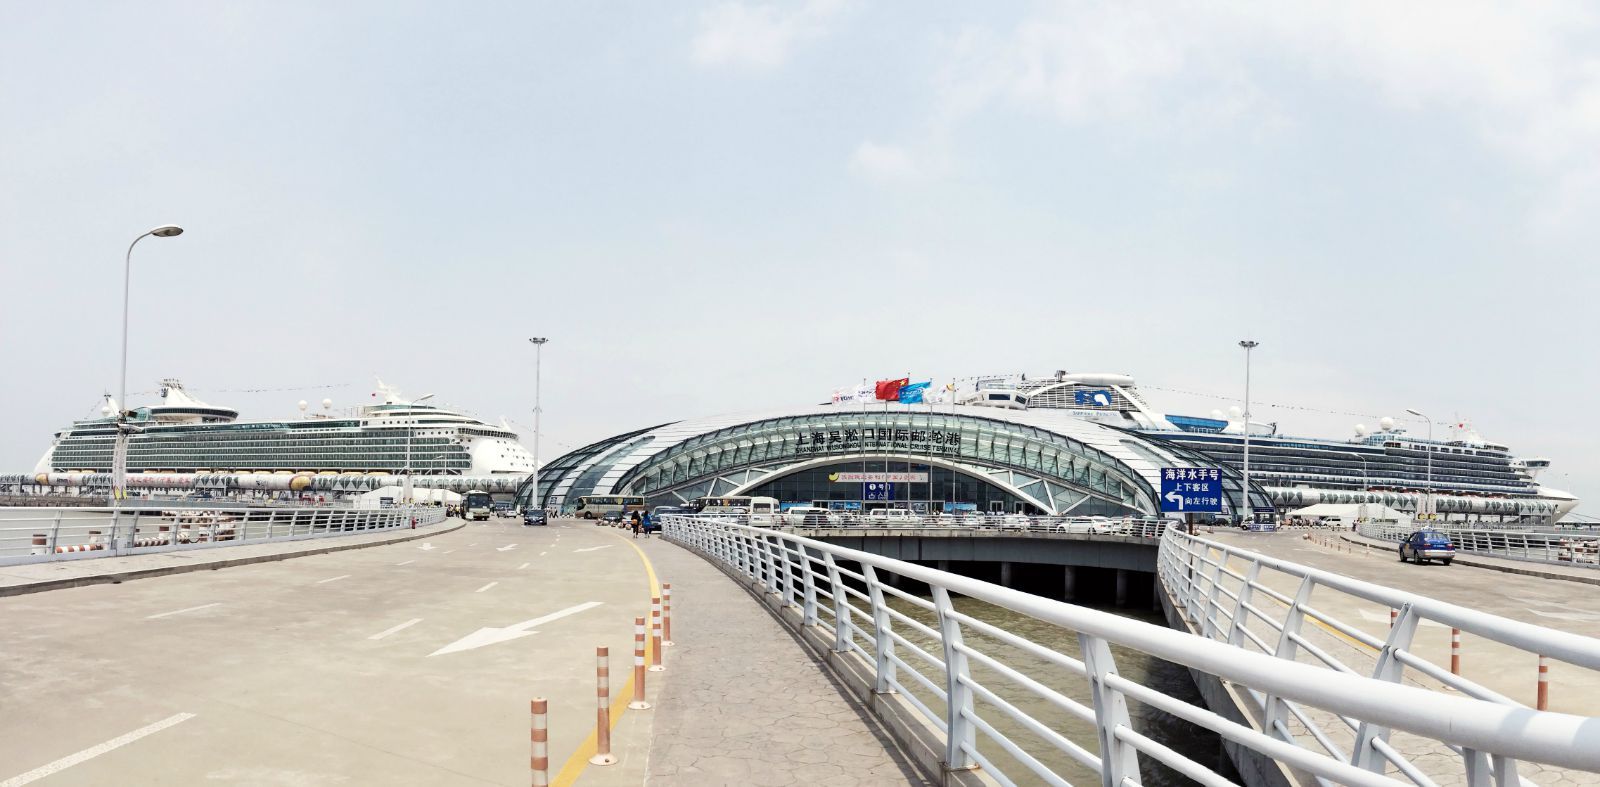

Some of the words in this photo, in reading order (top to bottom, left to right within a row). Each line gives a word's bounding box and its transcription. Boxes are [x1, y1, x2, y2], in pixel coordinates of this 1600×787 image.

[796, 428, 960, 446] 上海吴淞口国际邮轮港
[796, 445, 825, 454] SHANGHAI
[862, 441, 908, 449] NTERNATIONAL
[910, 443, 931, 451] CRUISE
[1165, 468, 1219, 481] 海洋水手号
[1174, 482, 1209, 492] 上下客区
[1184, 497, 1218, 506] 向左行驶
